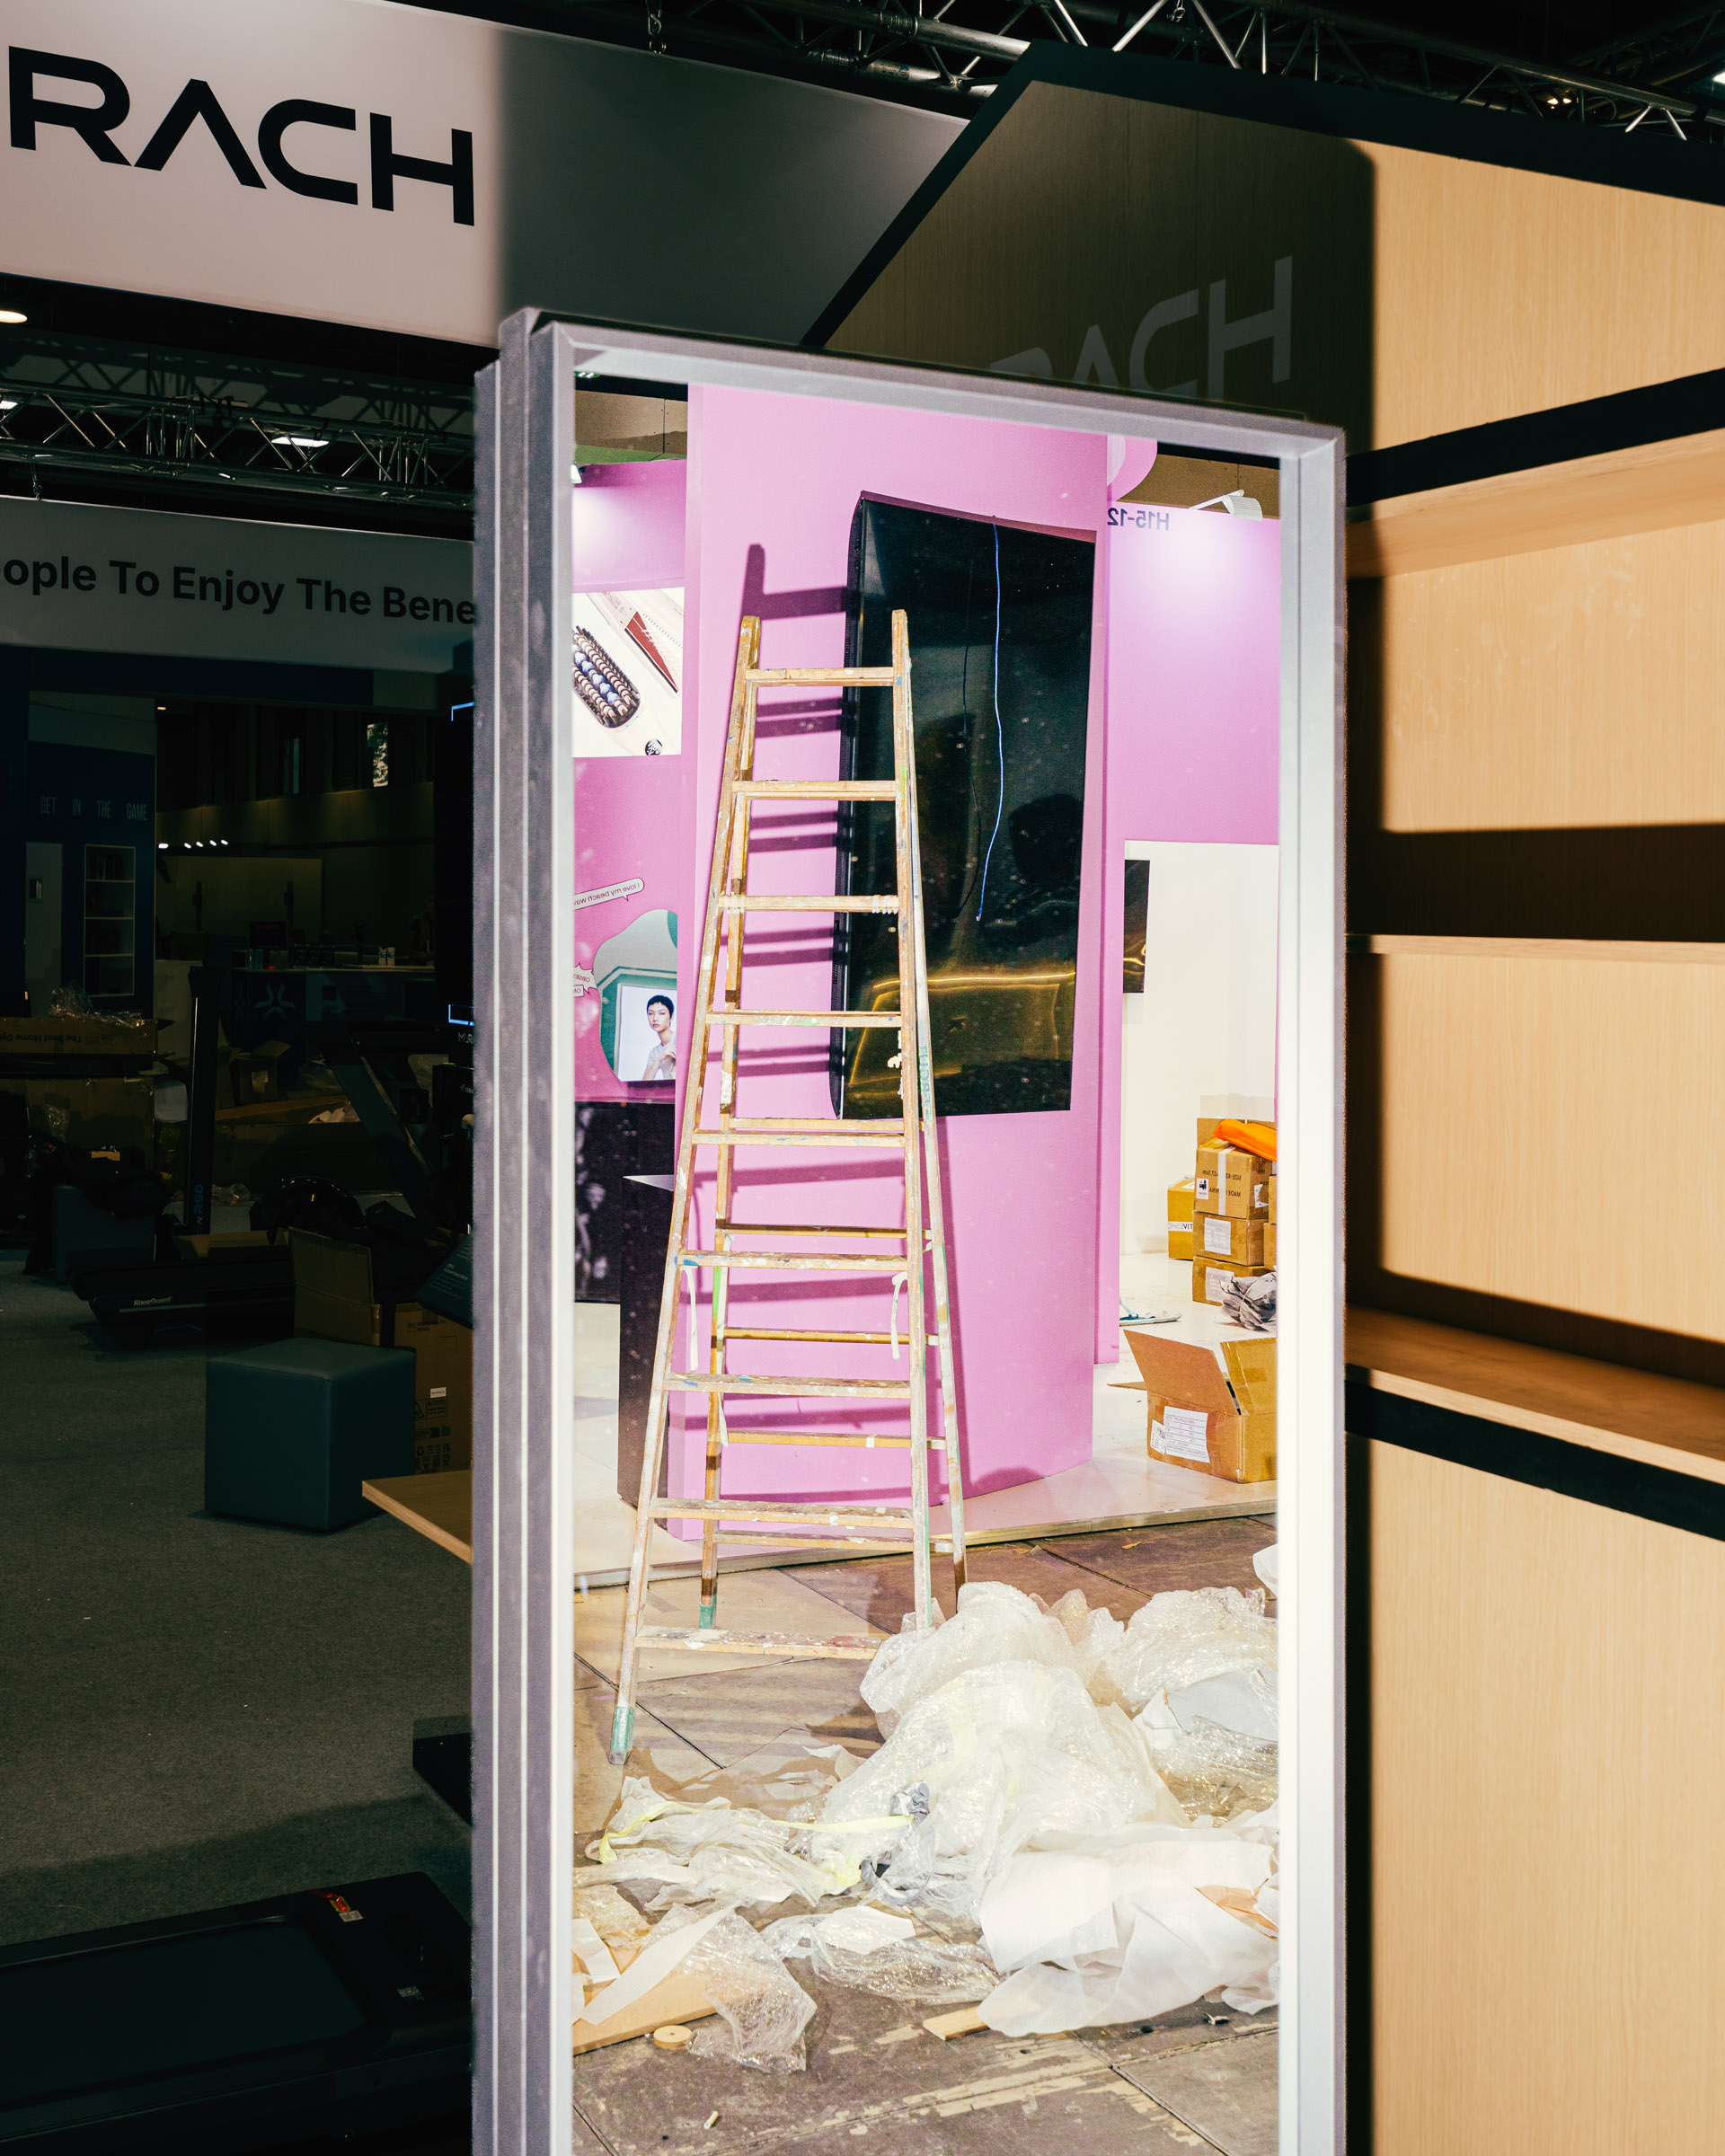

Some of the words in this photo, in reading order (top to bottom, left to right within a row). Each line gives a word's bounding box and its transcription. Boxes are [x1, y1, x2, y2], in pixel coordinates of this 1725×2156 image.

[8, 46, 475, 227] RACH
[990, 255, 1293, 401] ACH
[0, 556, 97, 596] ople
[109, 560, 160, 596] To
[172, 565, 285, 614] Enjoy
[296, 578, 372, 615] The
[40, 796, 58, 816] GET
[72, 797, 83, 817] IN
[96, 800, 112, 818] THE
[126, 802, 148, 821] GAME
